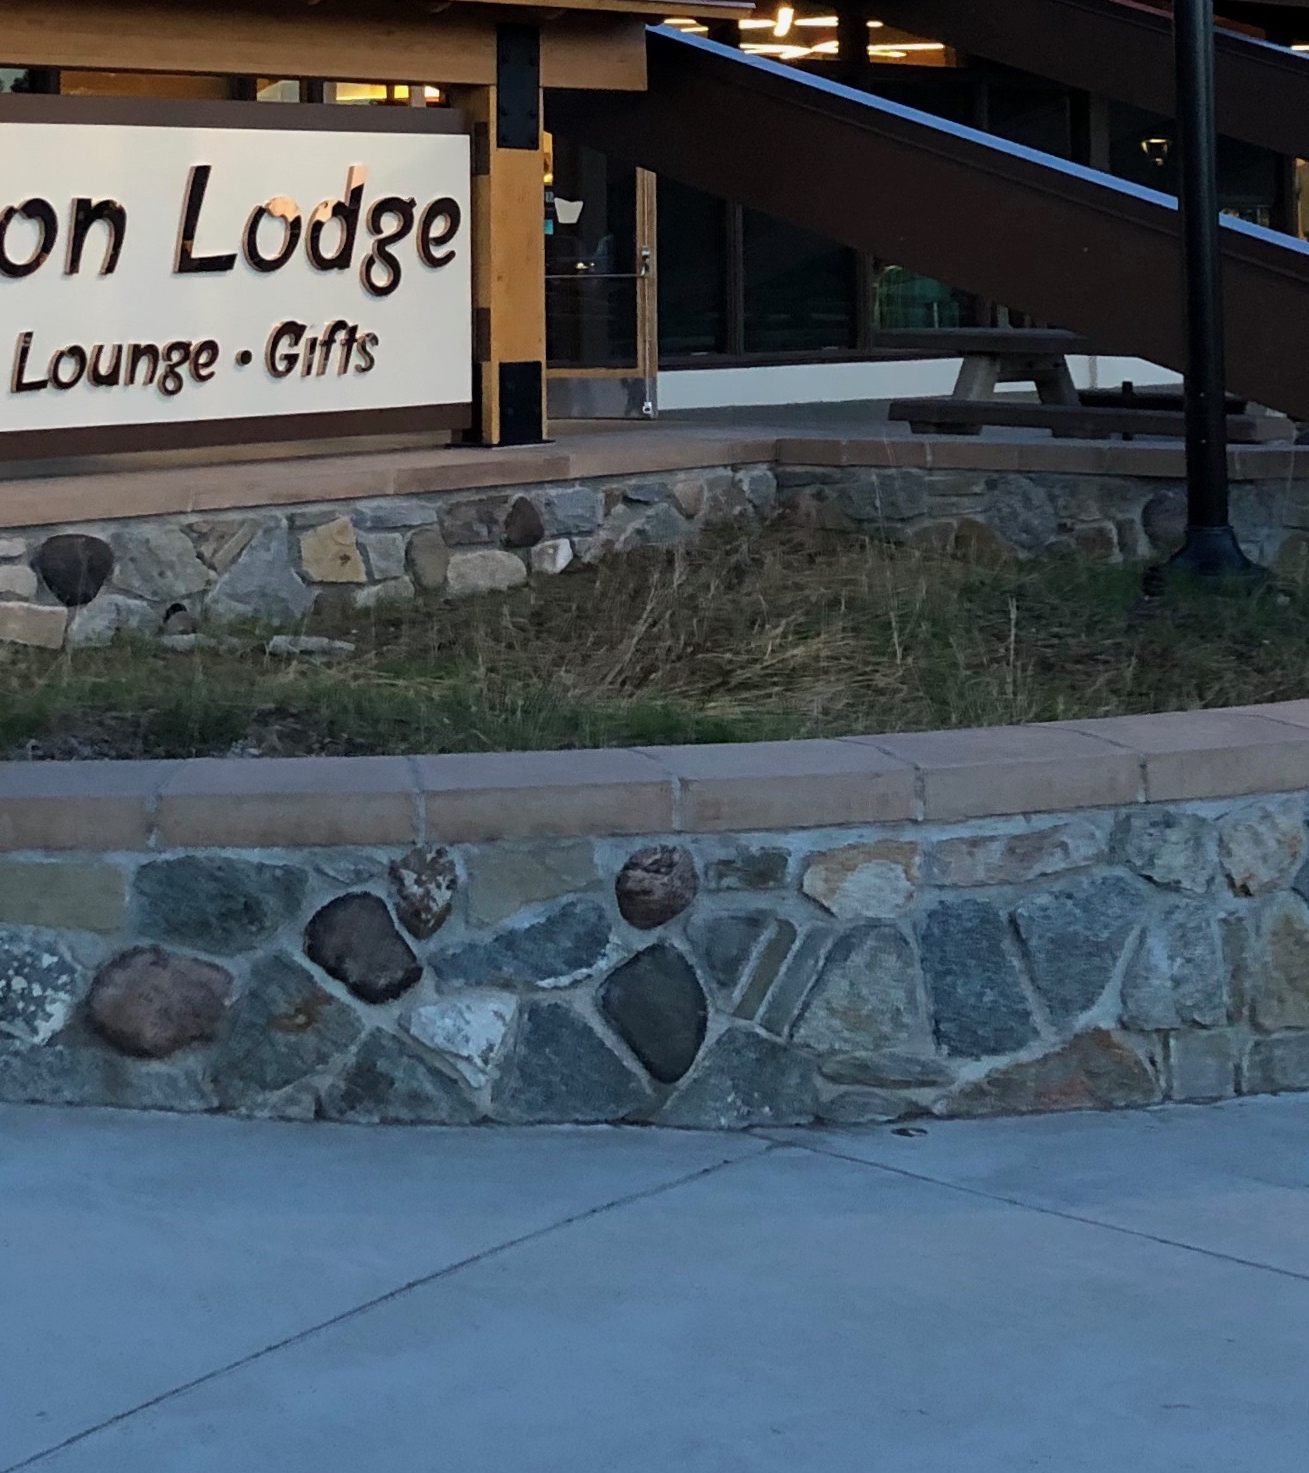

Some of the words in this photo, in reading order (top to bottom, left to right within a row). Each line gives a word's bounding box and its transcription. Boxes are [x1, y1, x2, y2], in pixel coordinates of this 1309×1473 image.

[172, 163, 463, 298] Lodge
[9, 331, 220, 397] Lounge
[264, 319, 382, 379] Gifts
